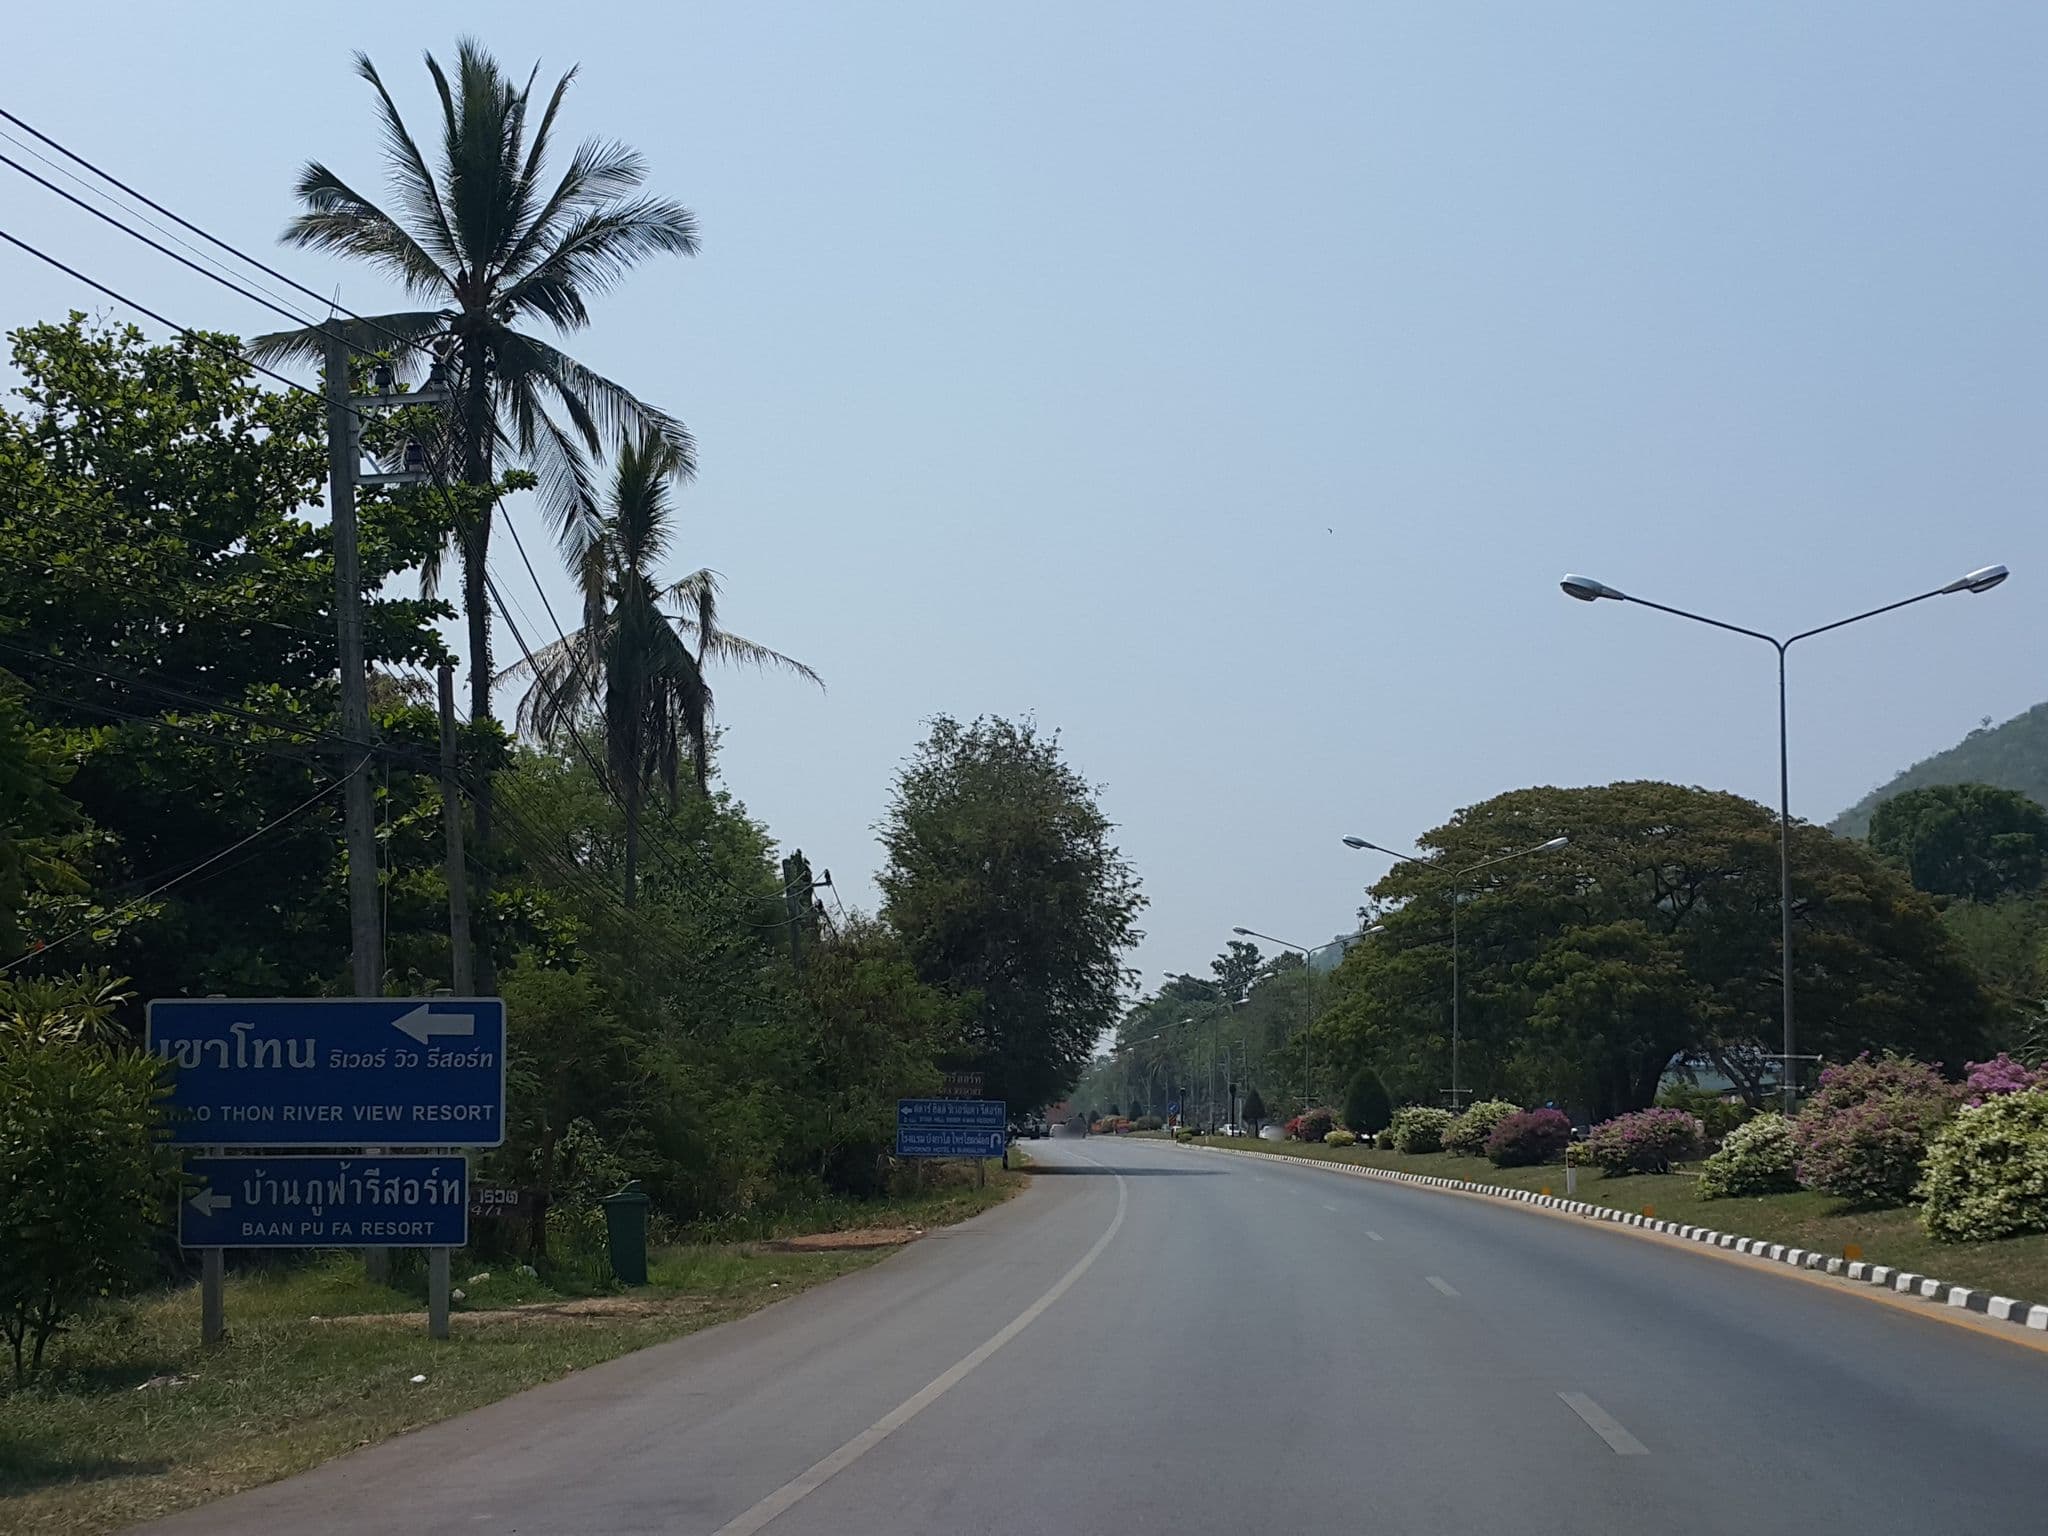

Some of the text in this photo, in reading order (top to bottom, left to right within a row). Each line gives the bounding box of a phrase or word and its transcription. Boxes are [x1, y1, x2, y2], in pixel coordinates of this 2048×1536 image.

[329, 1047, 388, 1068] ริเวอร์
[394, 1048, 420, 1068] วิว
[426, 1046, 494, 1068] รีสอร์ท
[220, 1105, 275, 1121] THON
[283, 1105, 344, 1121] RIVER
[352, 1105, 404, 1121] VIEW
[412, 1104, 494, 1121] RESORT
[243, 1161, 460, 1217] บ้านภูฟ้ารีสอร์ท
[242, 1222, 435, 1236] BAAN PU FA RESORT
